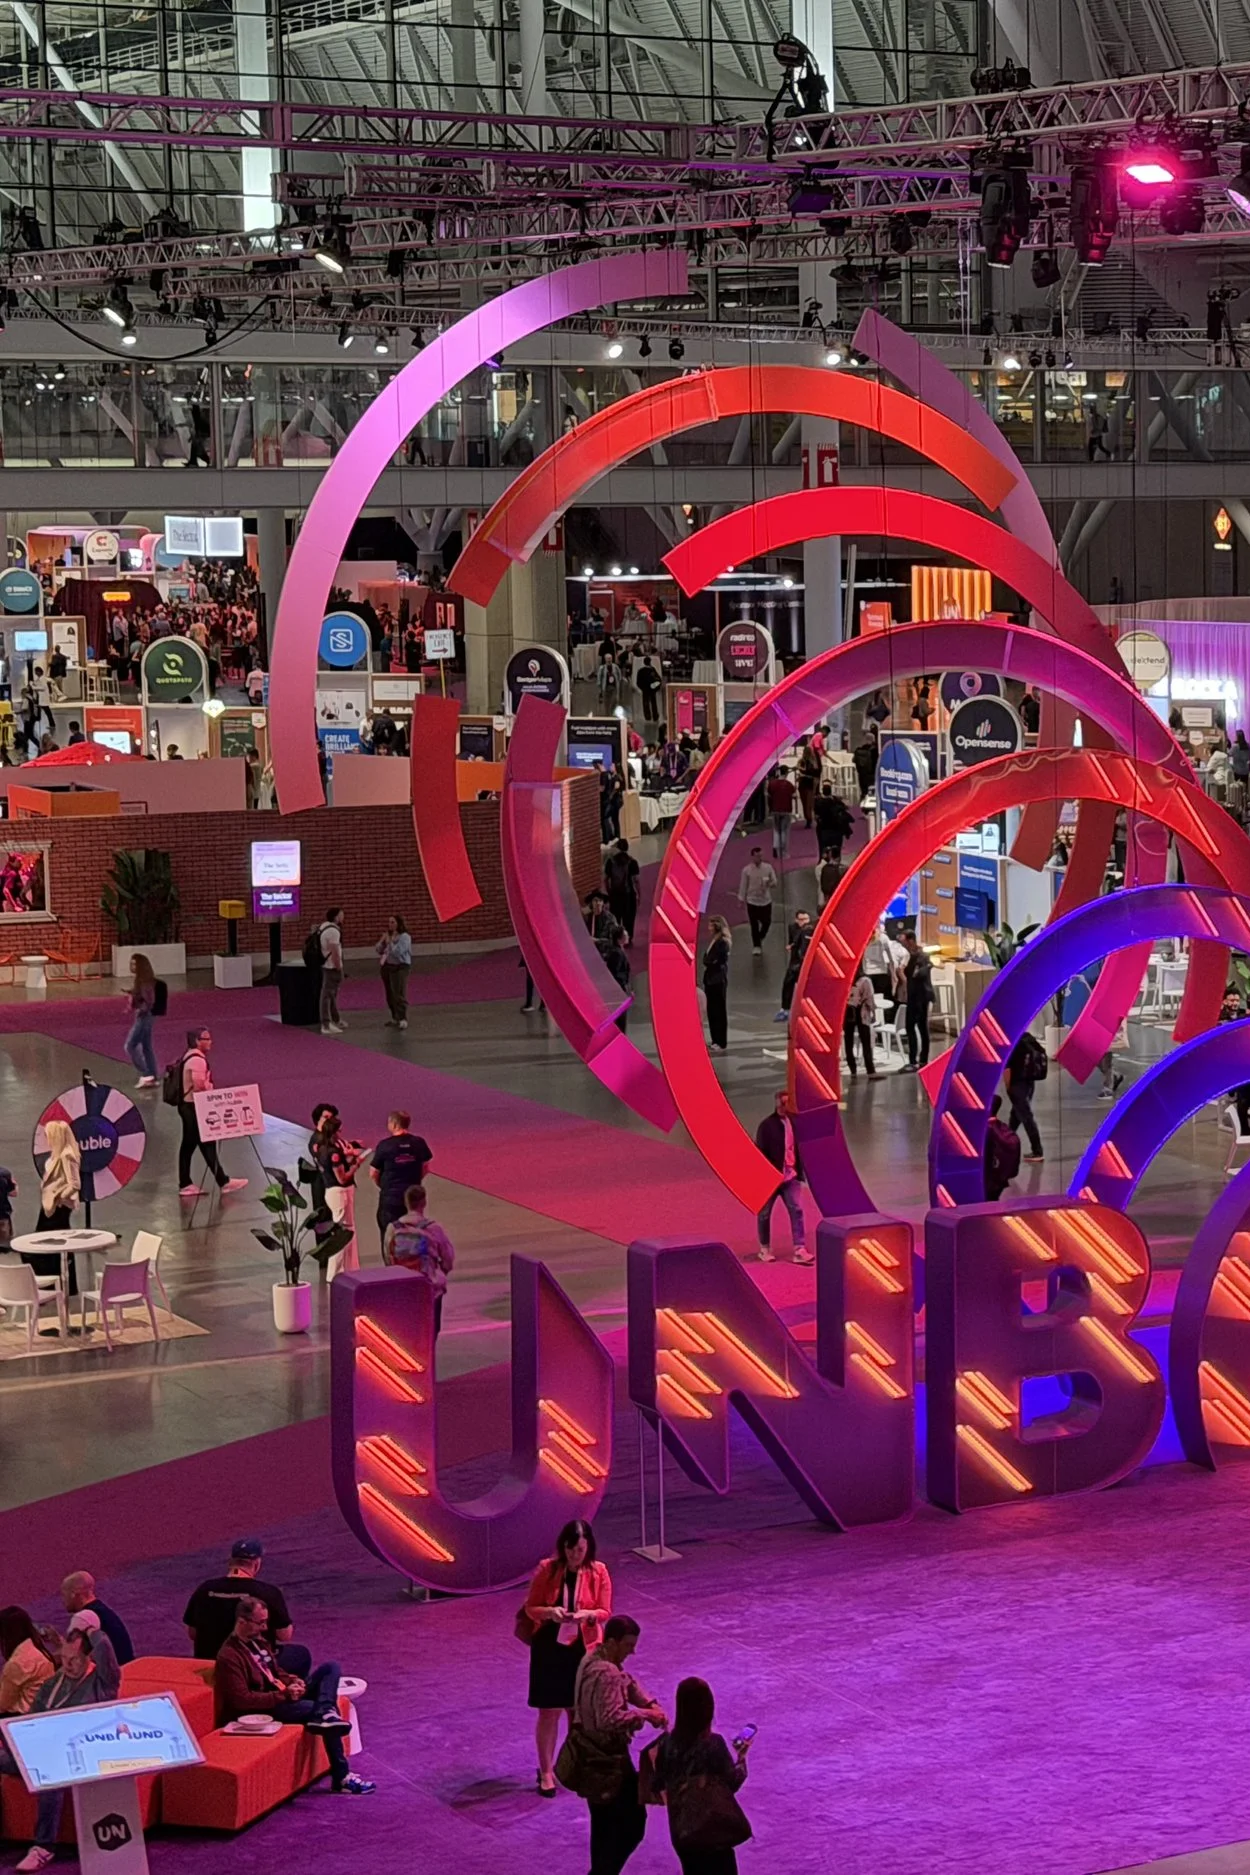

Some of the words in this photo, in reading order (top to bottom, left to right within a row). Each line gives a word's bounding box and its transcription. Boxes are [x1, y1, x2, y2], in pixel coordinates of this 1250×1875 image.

[955, 736, 1012, 750] Opensense
[206, 1094, 222, 1102] SPIN
[224, 1092, 232, 1100] TO
[80, 1136, 111, 1150] uble
[98, 1823, 126, 1842] UN
